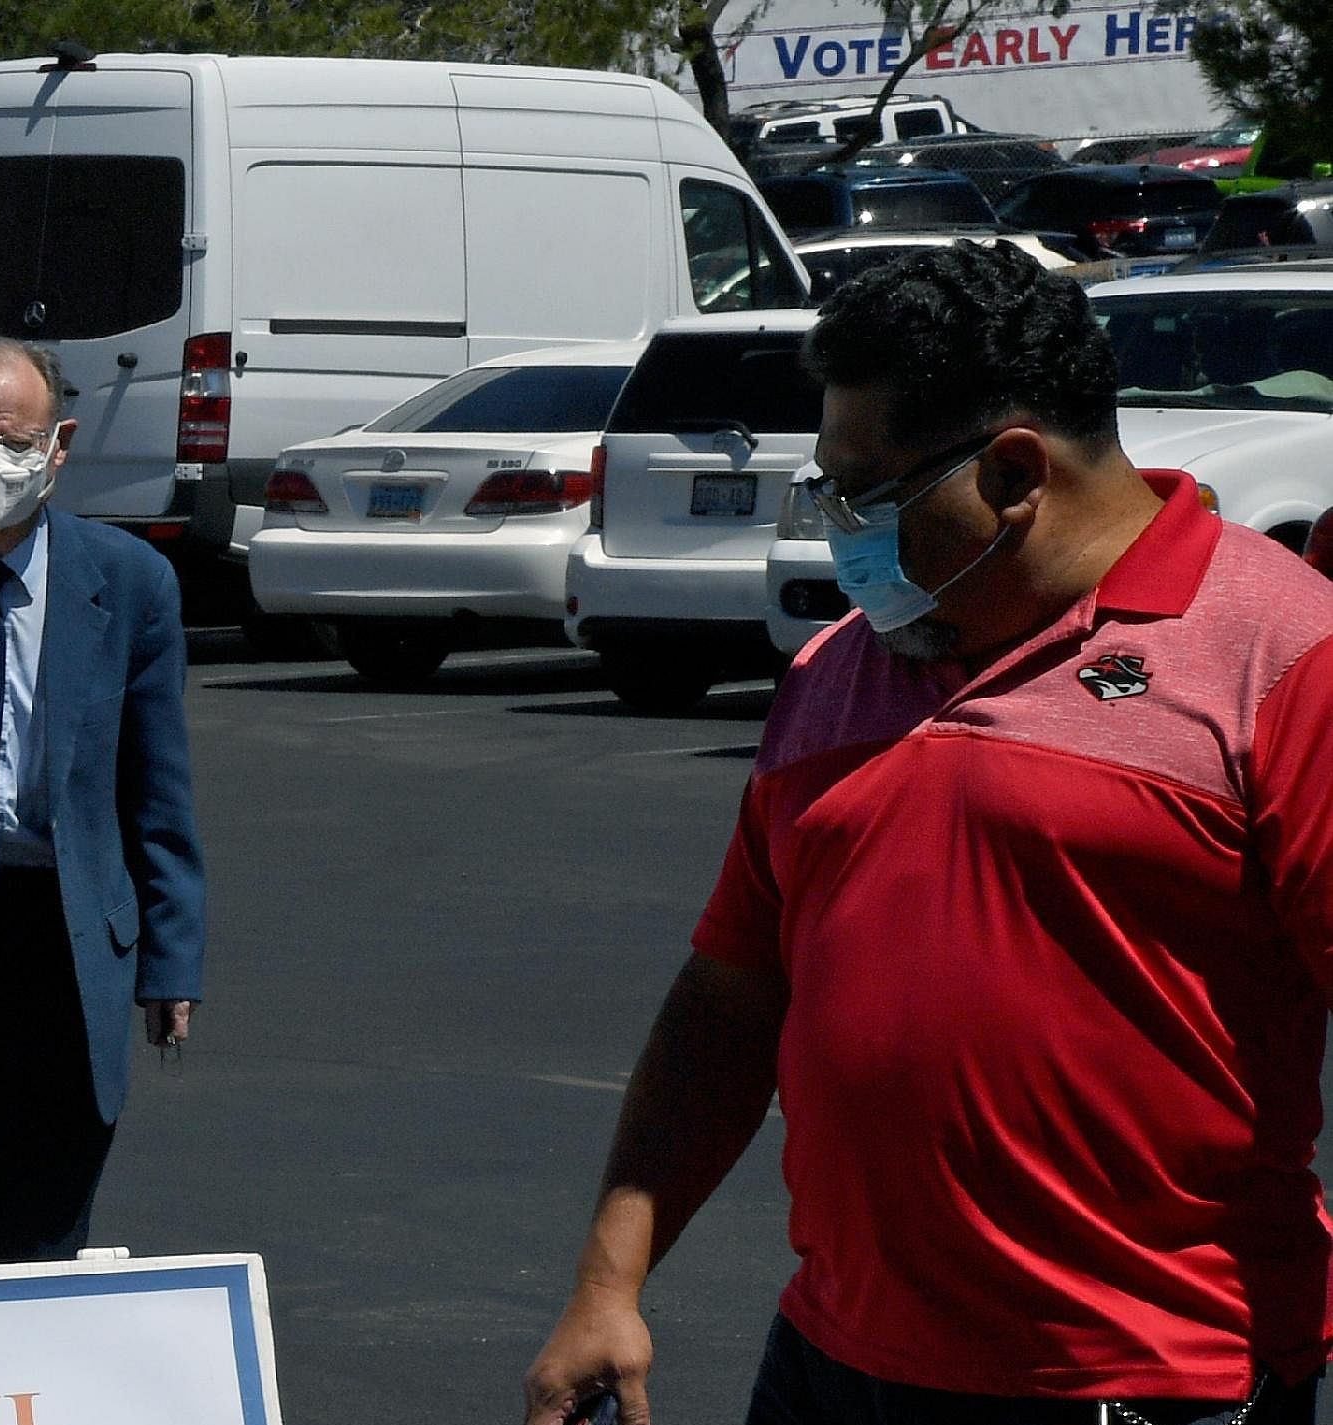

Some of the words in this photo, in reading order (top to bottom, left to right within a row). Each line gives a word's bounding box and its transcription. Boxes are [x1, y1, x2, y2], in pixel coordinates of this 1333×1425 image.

[774, 34, 903, 79] VOTE
[924, 23, 1080, 70] EARLY
[1105, 11, 1230, 56] HER
